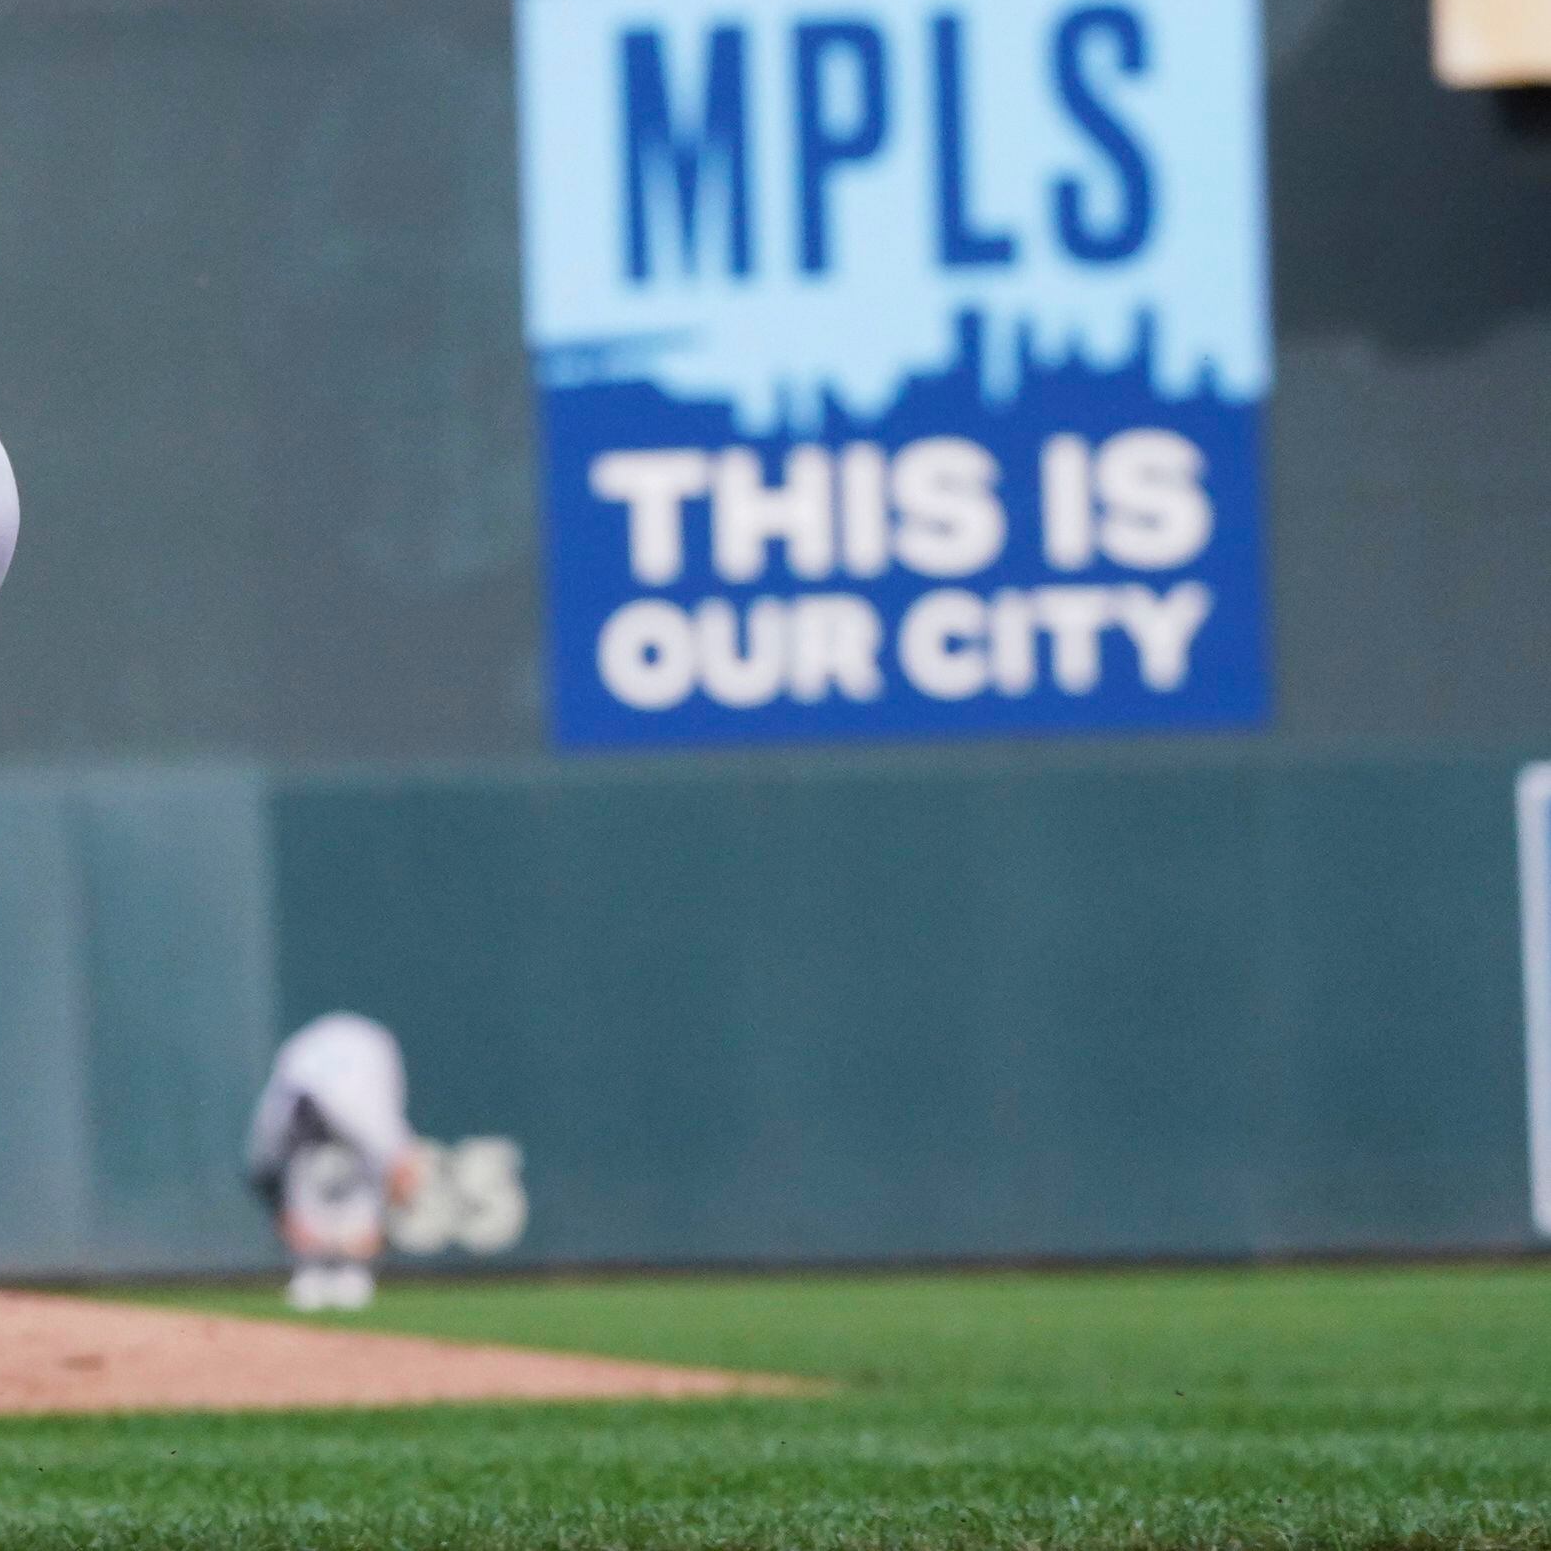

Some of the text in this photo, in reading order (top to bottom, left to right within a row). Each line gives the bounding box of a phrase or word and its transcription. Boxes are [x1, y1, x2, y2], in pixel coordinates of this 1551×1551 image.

[617, 0, 1158, 284] MPLS
[590, 427, 1216, 586] THIS IS
[597, 580, 1214, 710] OUR CITY
